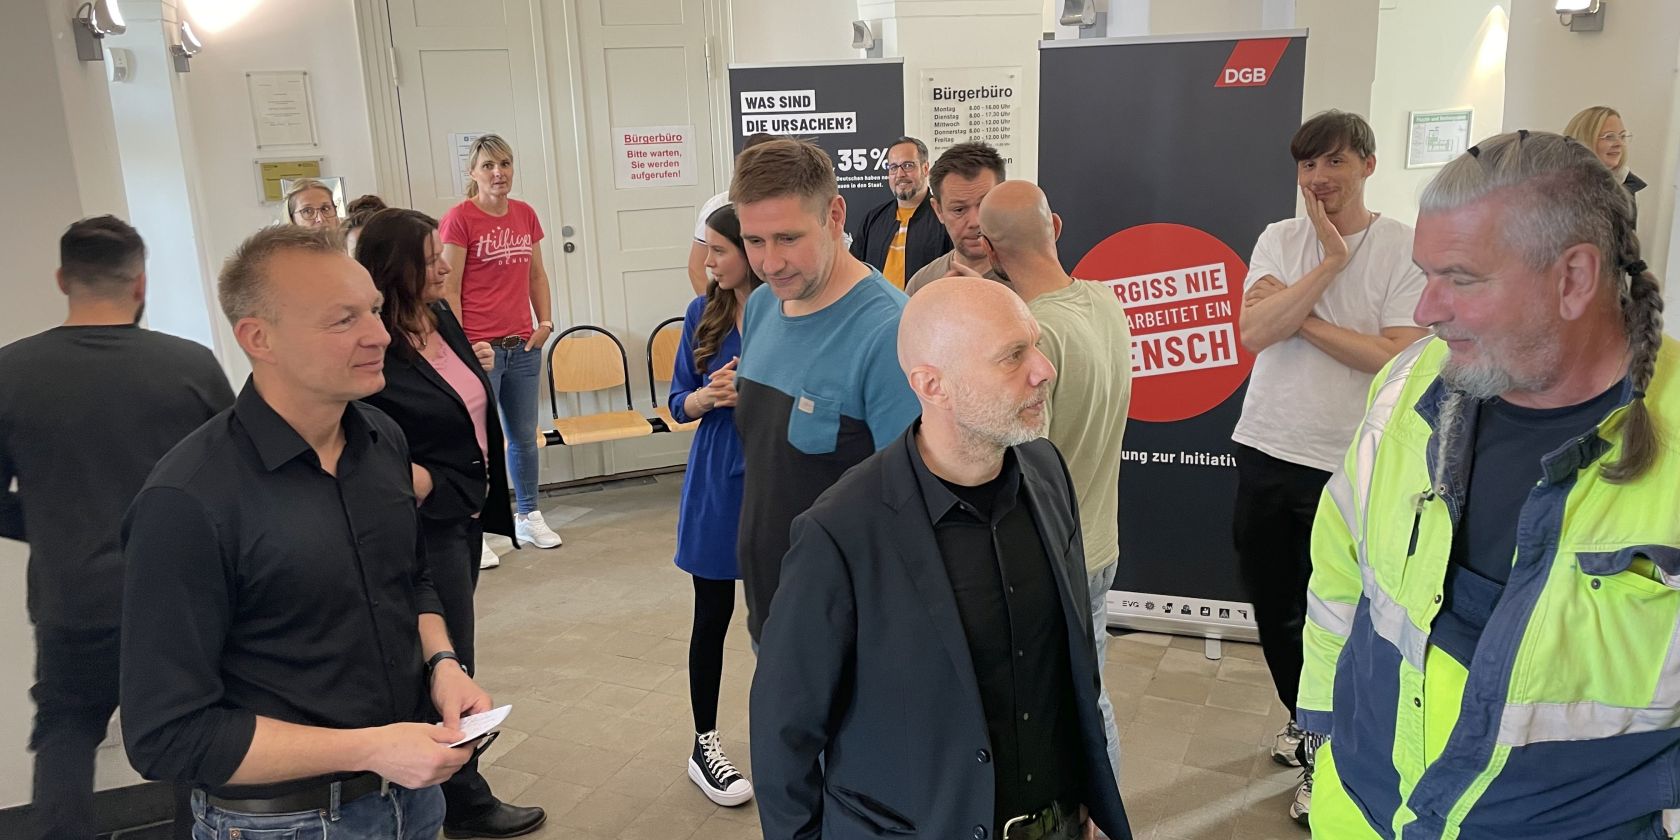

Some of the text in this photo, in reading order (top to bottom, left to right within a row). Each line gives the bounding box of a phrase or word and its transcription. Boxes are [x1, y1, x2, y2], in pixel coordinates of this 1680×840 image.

[1224, 67, 1266, 84] DGB
[933, 86, 1013, 102] Bürgerbüro
[745, 95, 811, 109] WAS SIND
[746, 117, 854, 133] DIE URSACHEN?
[624, 133, 683, 144] Bürgerbüro
[627, 149, 682, 158] Bitte warten,
[837, 148, 868, 171] 35
[631, 160, 680, 169] Sie werden
[631, 170, 681, 181] aufgerufen!
[1113, 268, 1223, 303] RGISS NIE
[1205, 300, 1232, 319] EIN
[1121, 450, 1148, 464] ung
[1152, 452, 1176, 463] zur
